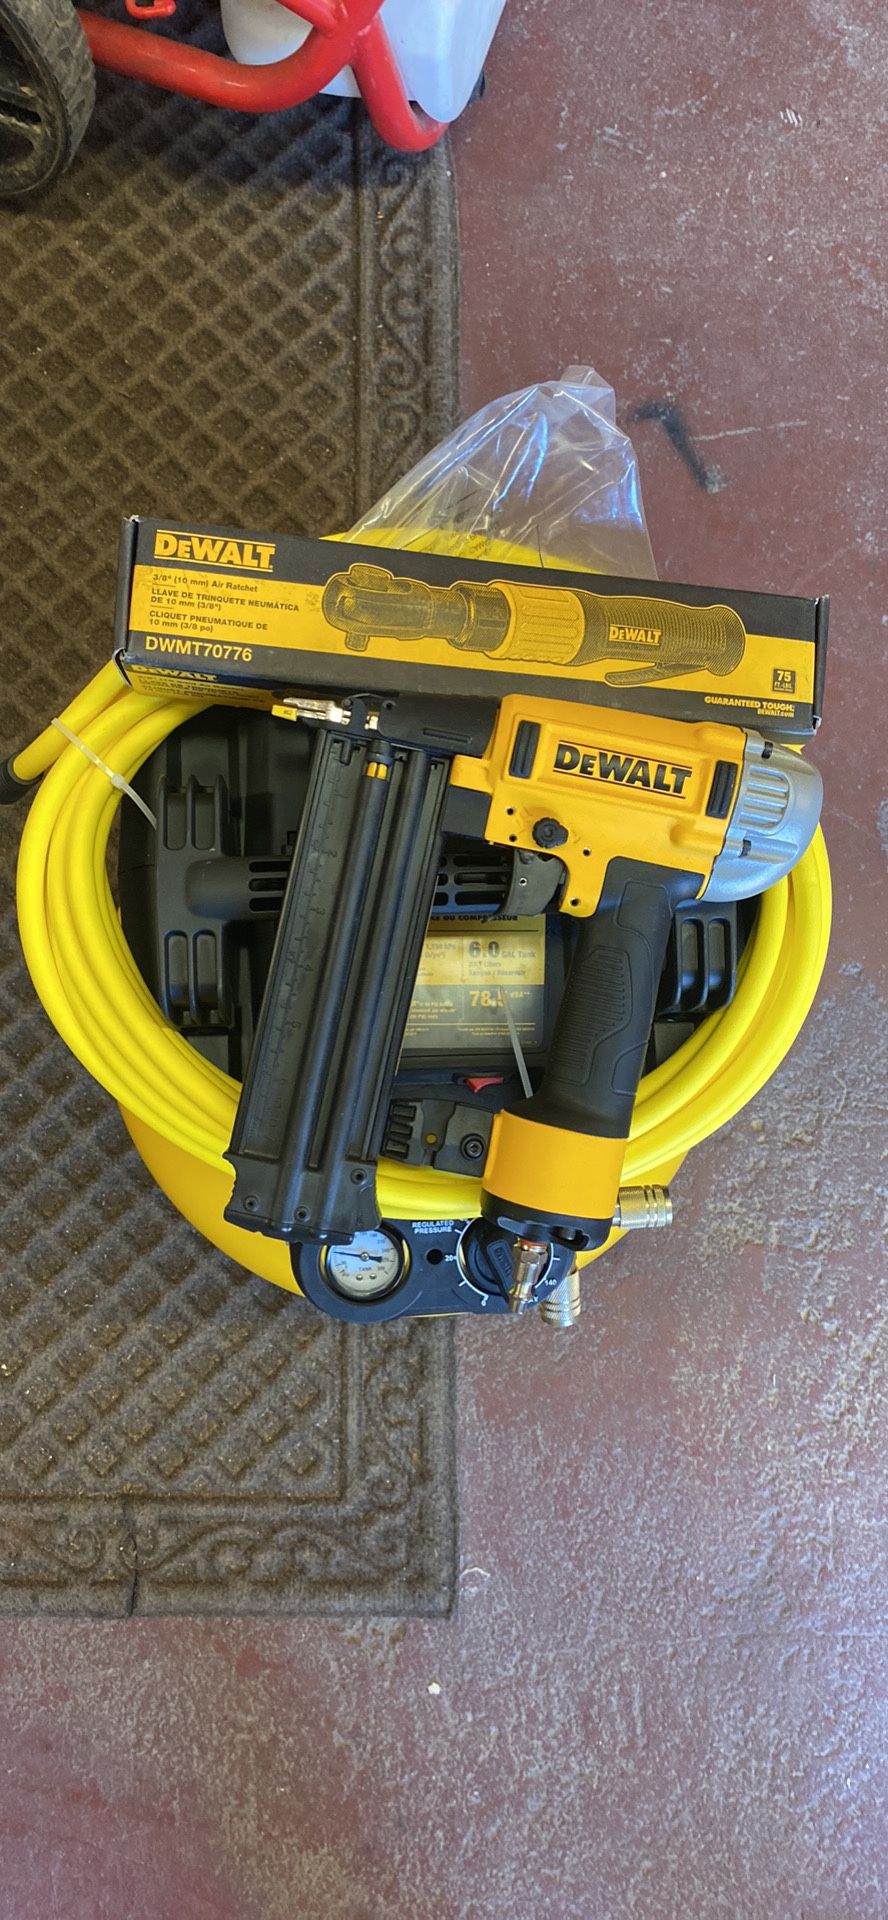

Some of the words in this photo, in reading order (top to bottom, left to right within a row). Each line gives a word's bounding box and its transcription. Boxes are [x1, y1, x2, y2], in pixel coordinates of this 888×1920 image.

[174, 576, 188, 585] (10
[190, 579, 209, 588] mm)
[211, 580, 225, 588] Air
[226, 582, 258, 593] Ratchet
[150, 596, 163, 604] DE
[166, 597, 177, 606] 10
[179, 600, 195, 608] mm
[151, 588, 179, 598] LLAVE
[182, 591, 194, 599] DE
[197, 593, 246, 606] TRINQUETE
[248, 599, 300, 612] NEUMÁTICA
[149, 610, 188, 621] CLIQUET
[190, 614, 254, 629] PNEUMATIQUE
[256, 622, 269, 631] DE
[149, 618, 159, 626] 10
[162, 621, 178, 629] mm
[180, 621, 198, 631] (3/8
[200, 624, 213, 633] po)
[145, 635, 253, 662] DWMT70776
[777, 670, 791, 682] 75
[704, 696, 761, 709] GUARANTEED
[469, 941, 500, 958] 6.0
[412, 1220, 455, 1228] REGULATED
[414, 1226, 453, 1235] PRESSURE
[445, 1254, 455, 1262] 20
